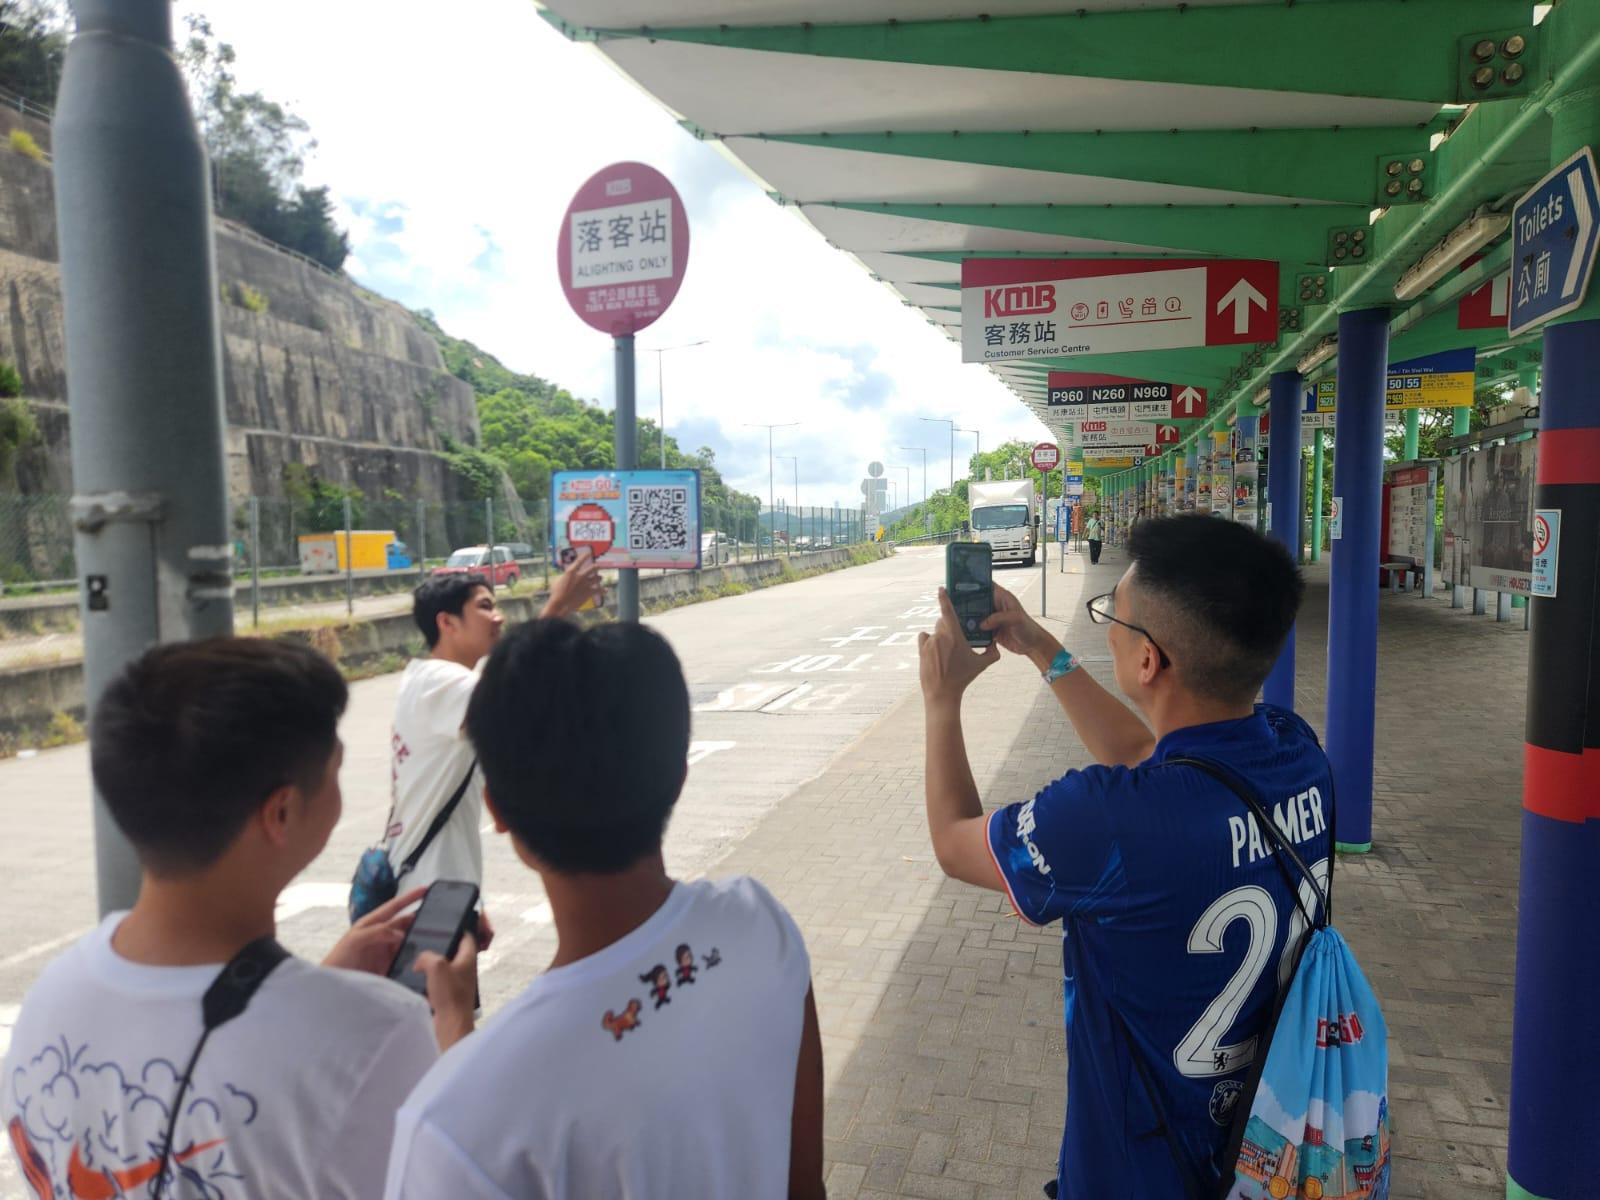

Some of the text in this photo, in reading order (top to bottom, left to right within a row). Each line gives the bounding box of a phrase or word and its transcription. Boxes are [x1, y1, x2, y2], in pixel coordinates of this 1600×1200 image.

[577, 208, 667, 253] 落客站
[1519, 193, 1563, 245] Toilets
[577, 256, 668, 277] ALIGHTING ONLY
[1517, 251, 1551, 308] 公廁
[984, 284, 1057, 319] KMB
[984, 321, 1056, 346] 客務站
[984, 344, 1090, 358] Customer Service Centre
[1052, 386, 1167, 402] P960 N260 N960
[1389, 379, 1402, 389] 50
[1407, 378, 1420, 388] 55
